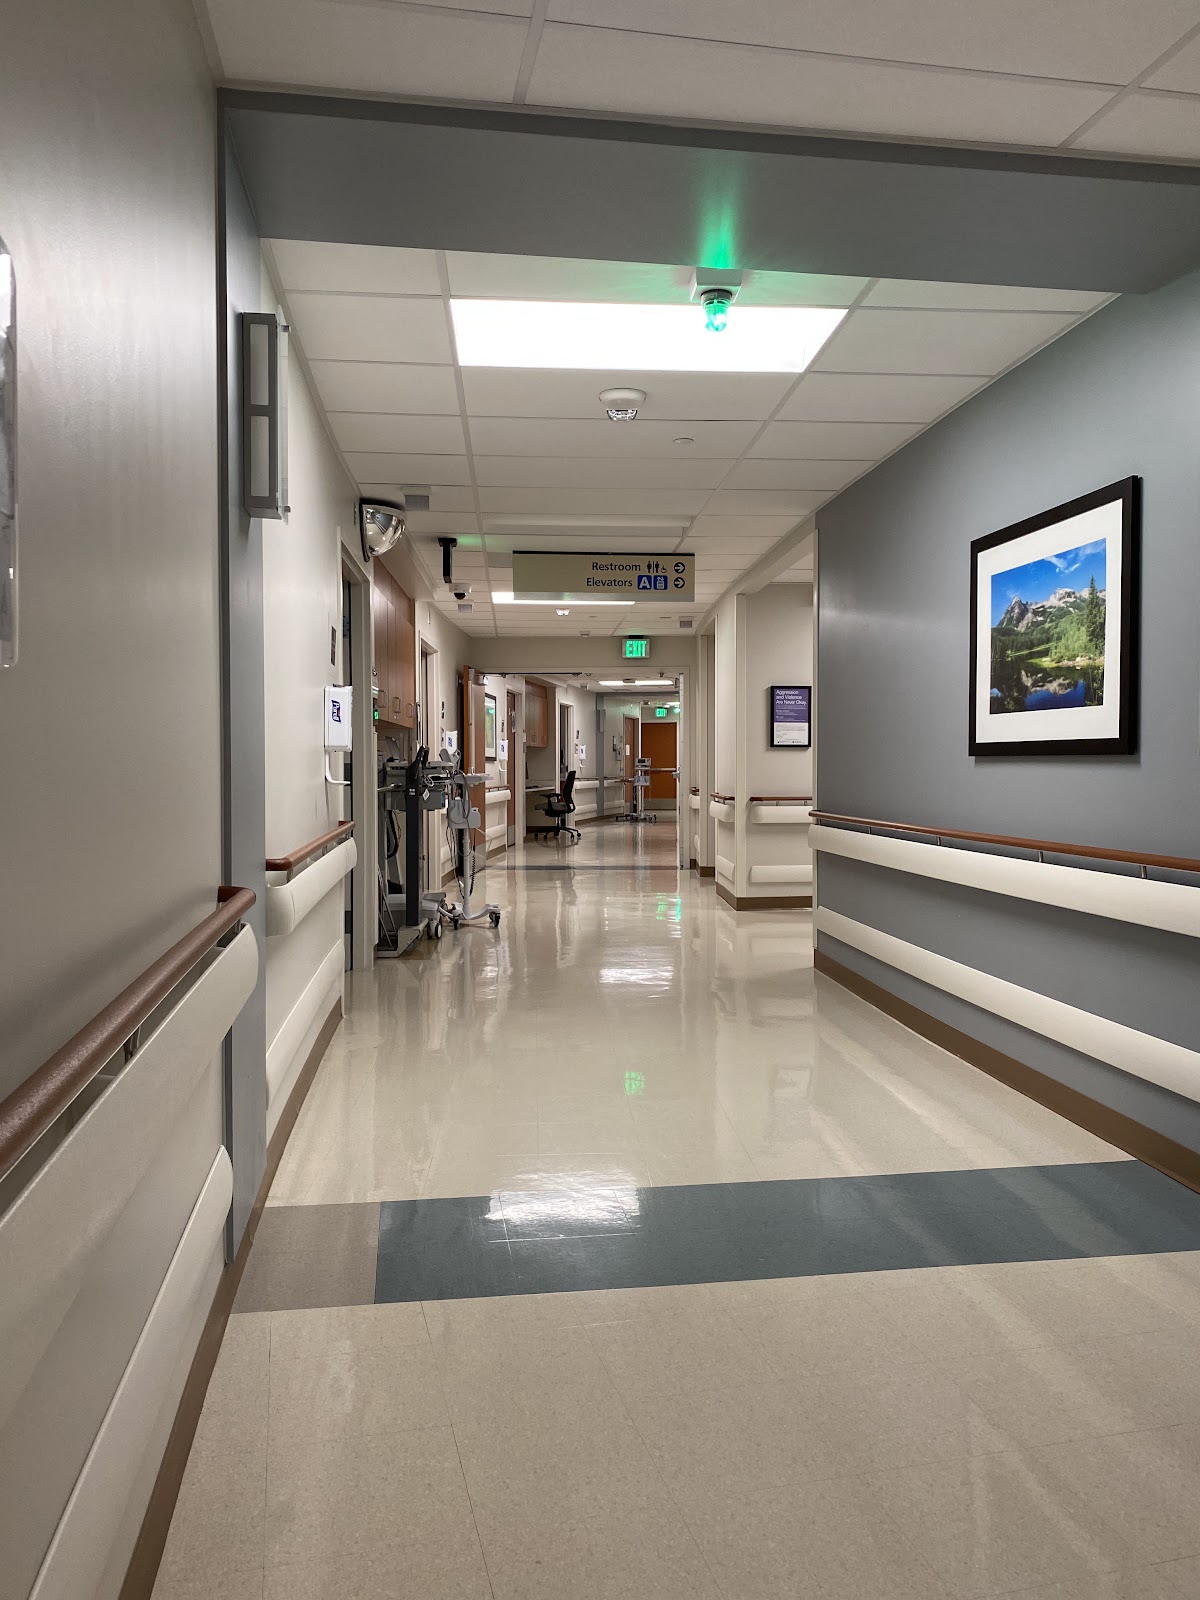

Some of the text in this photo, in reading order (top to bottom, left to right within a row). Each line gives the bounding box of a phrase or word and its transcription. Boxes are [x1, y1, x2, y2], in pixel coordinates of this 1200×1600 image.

[592, 561, 641, 572] Restroom
[586, 576, 651, 589] Elevators A
[626, 640, 647, 657] EXIT
